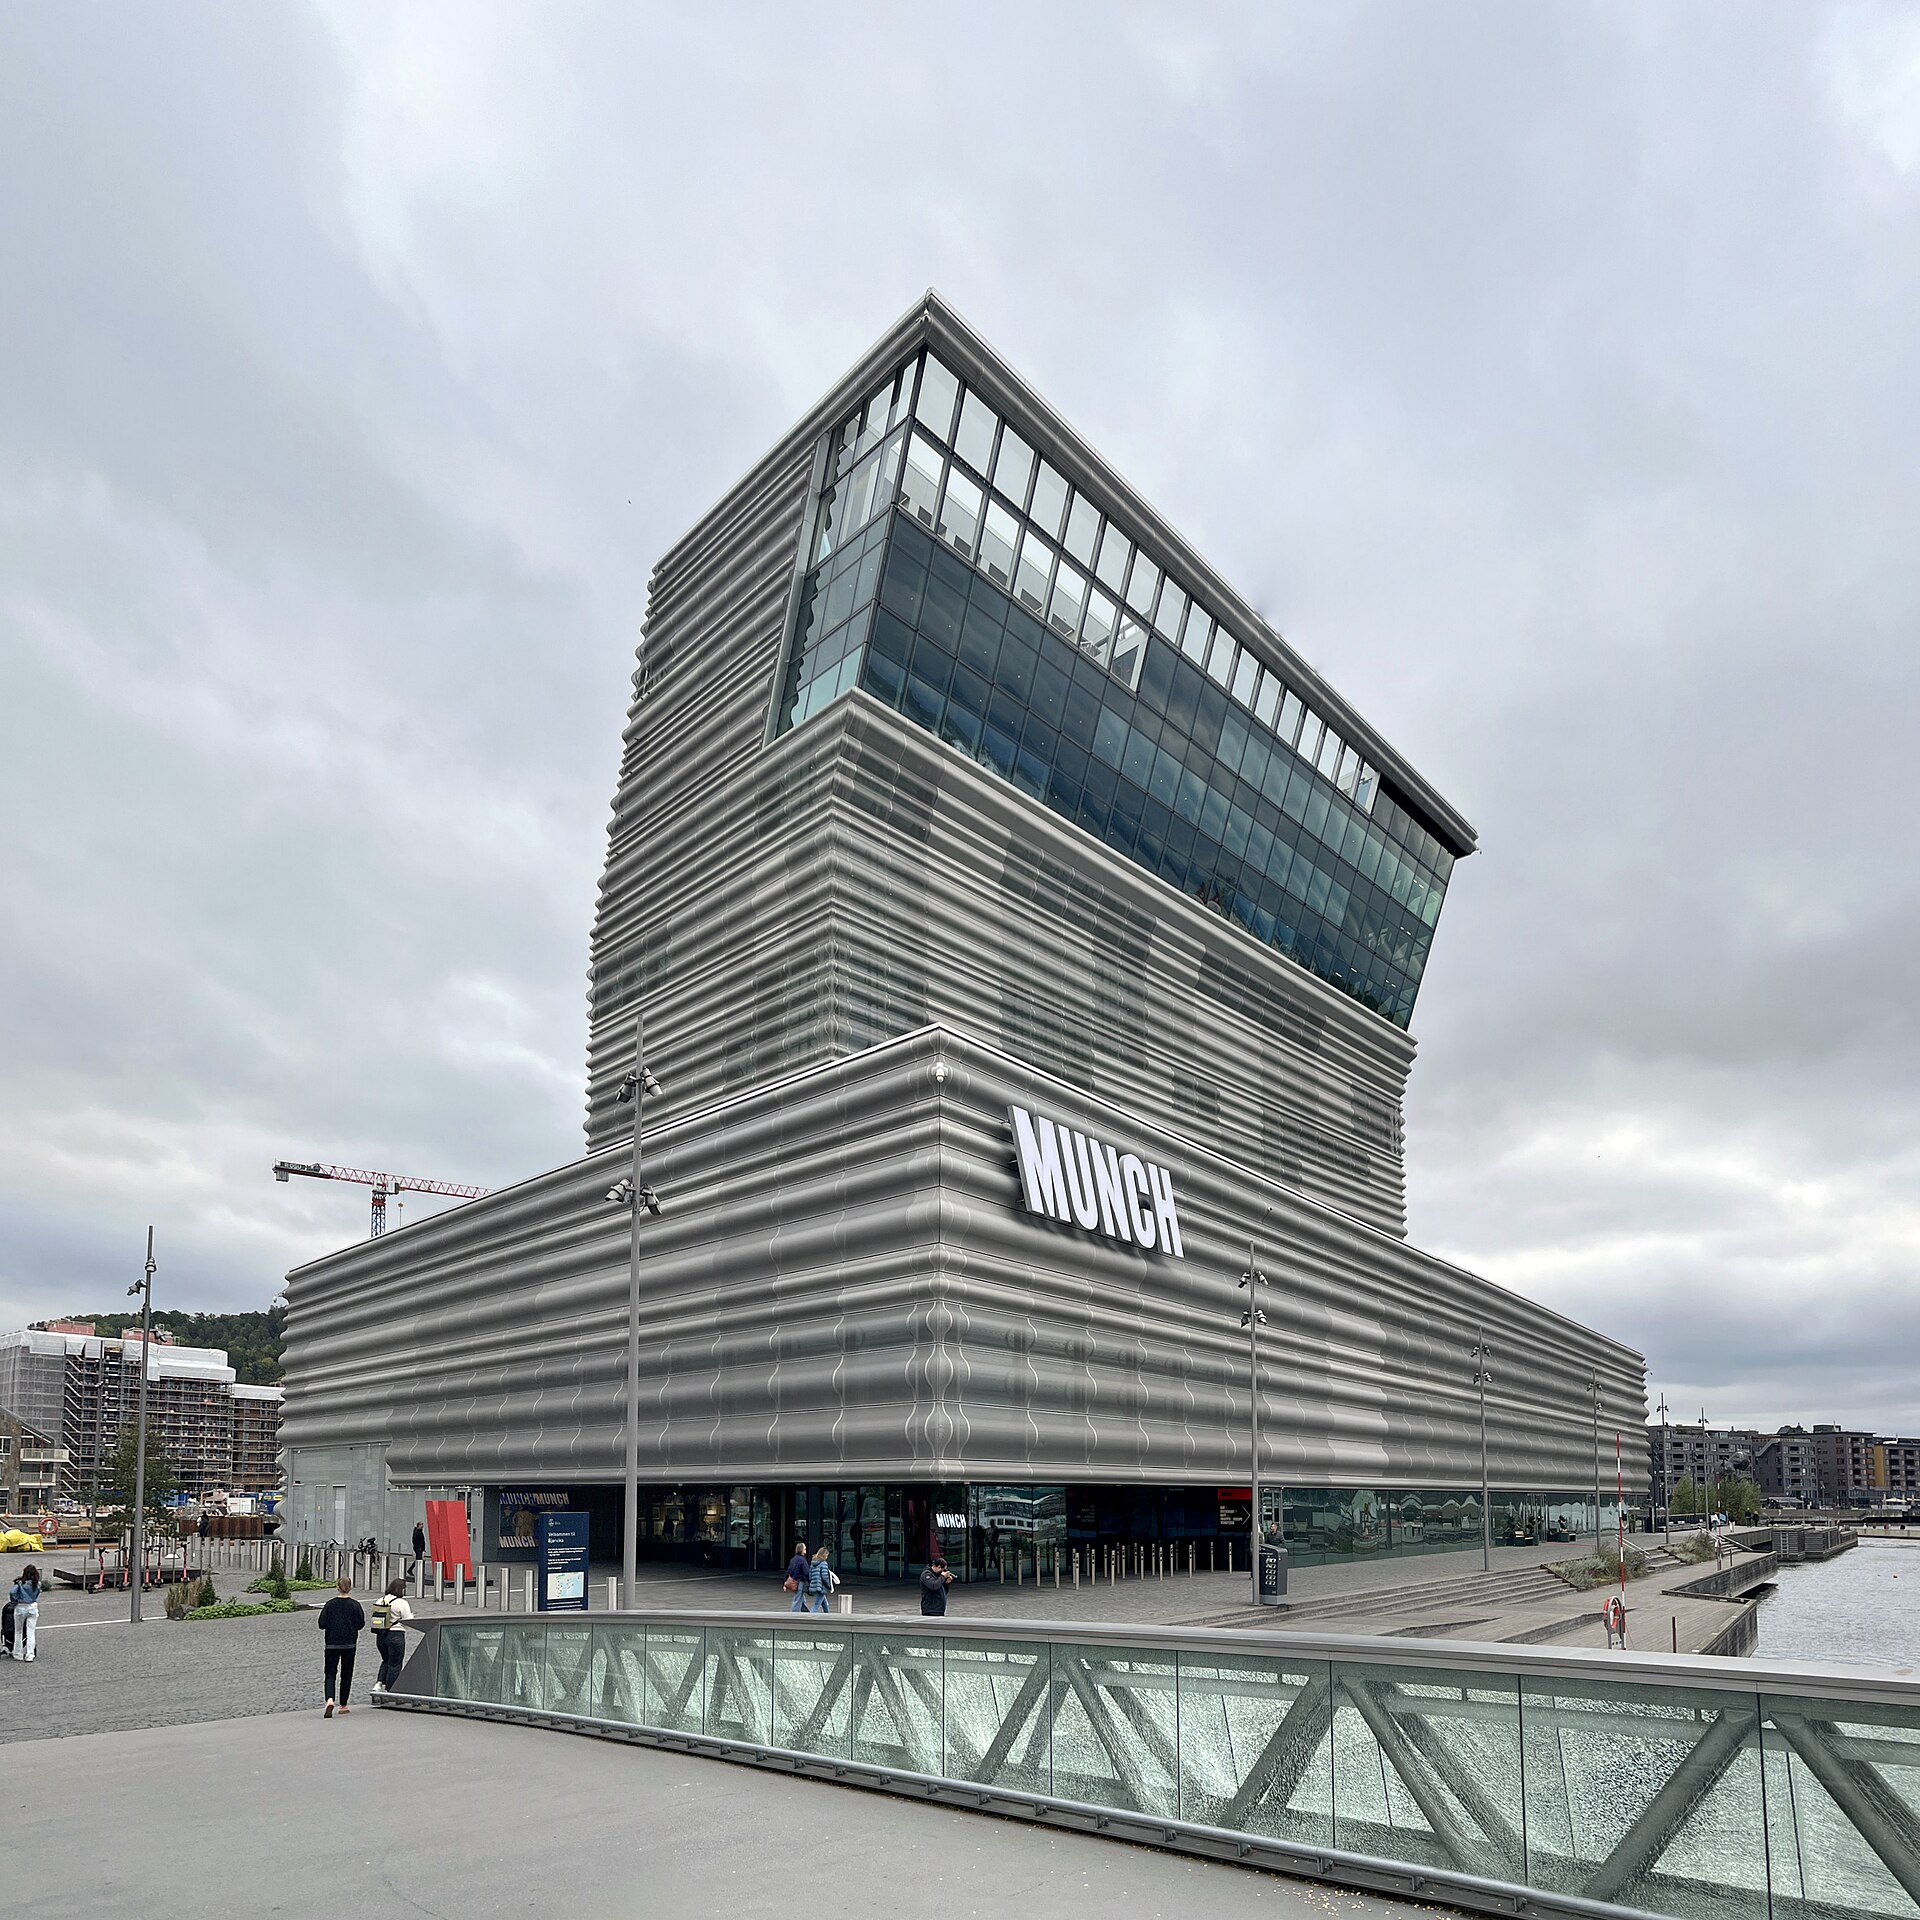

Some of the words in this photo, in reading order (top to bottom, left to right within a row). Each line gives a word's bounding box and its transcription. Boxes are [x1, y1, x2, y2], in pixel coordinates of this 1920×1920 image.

[1007, 1104, 1185, 1258] MUNCH
[536, 1493, 570, 1505] MUNCH
[936, 1514, 966, 1528] MUNCH
[499, 1536, 535, 1548] MUNCH
